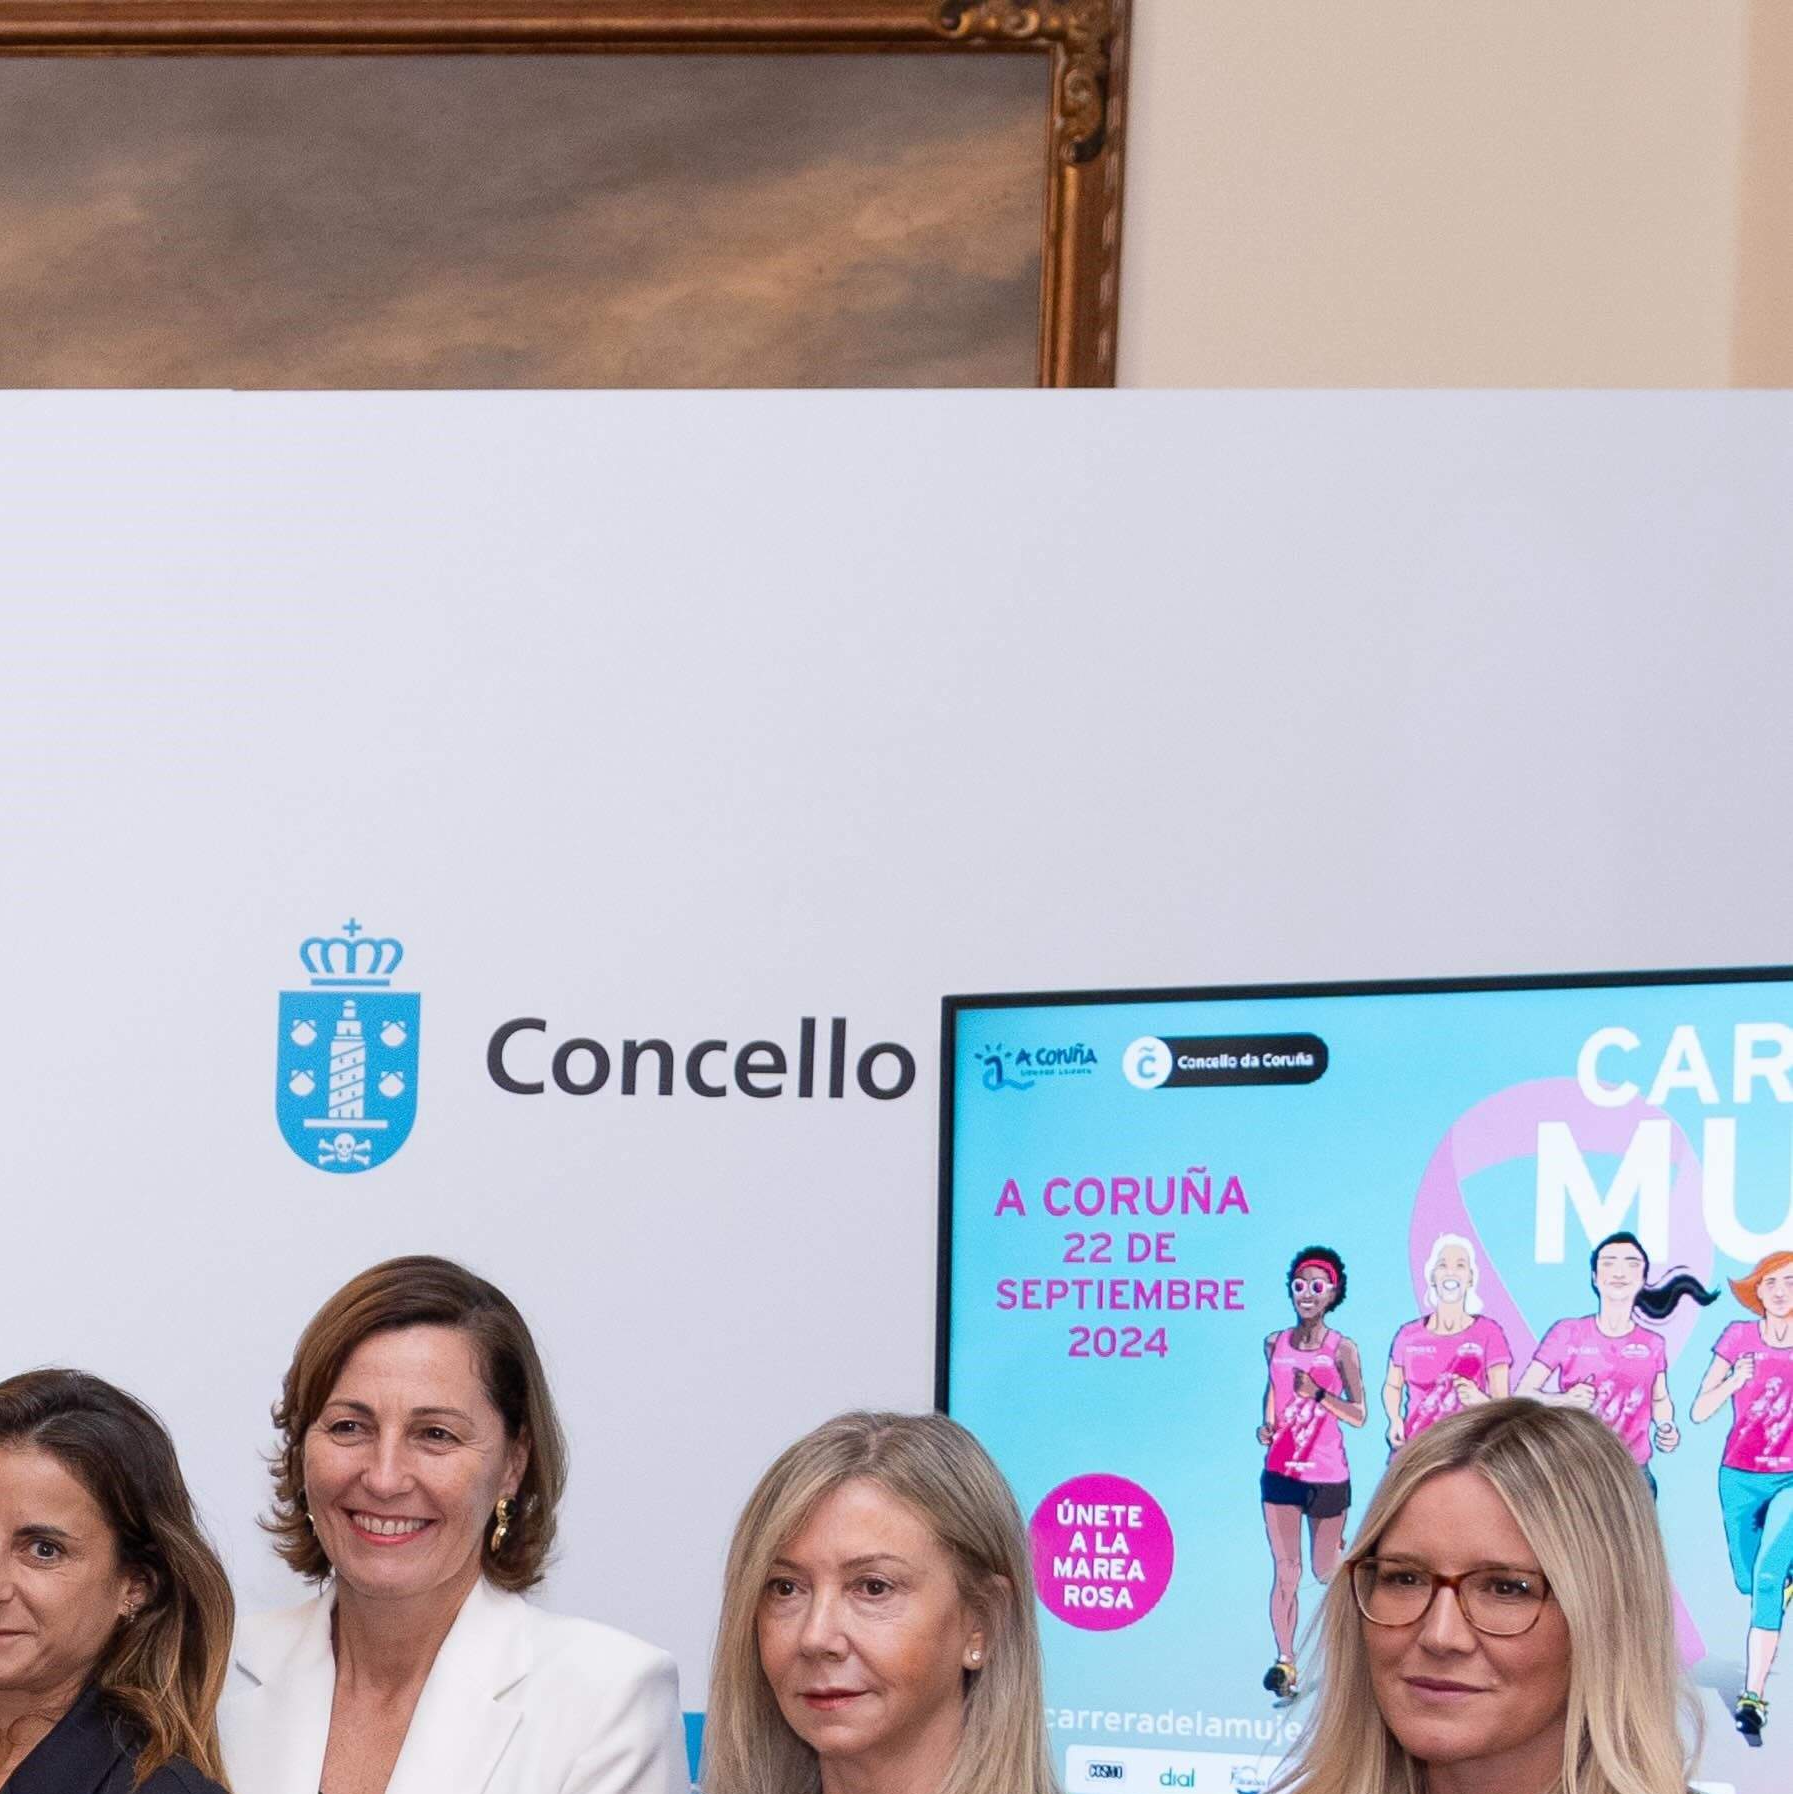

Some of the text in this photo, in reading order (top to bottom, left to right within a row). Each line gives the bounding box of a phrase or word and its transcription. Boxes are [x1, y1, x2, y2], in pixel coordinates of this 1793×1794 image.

[486, 1016, 916, 1101] Concello
[1177, 1052, 1314, 1070] Concello da Coruña
[994, 1166, 1250, 1217] A CORUÑA
[1063, 1231, 1176, 1263] 22 DE
[996, 1278, 1245, 1311] SEPTIEMBRE
[1068, 1325, 1169, 1358] 2024
[1056, 1498, 1142, 1528] ÚNETE
[1069, 1531, 1129, 1554] A LA
[1053, 1556, 1146, 1582] MAREA
[1064, 1584, 1134, 1609] ROSA
